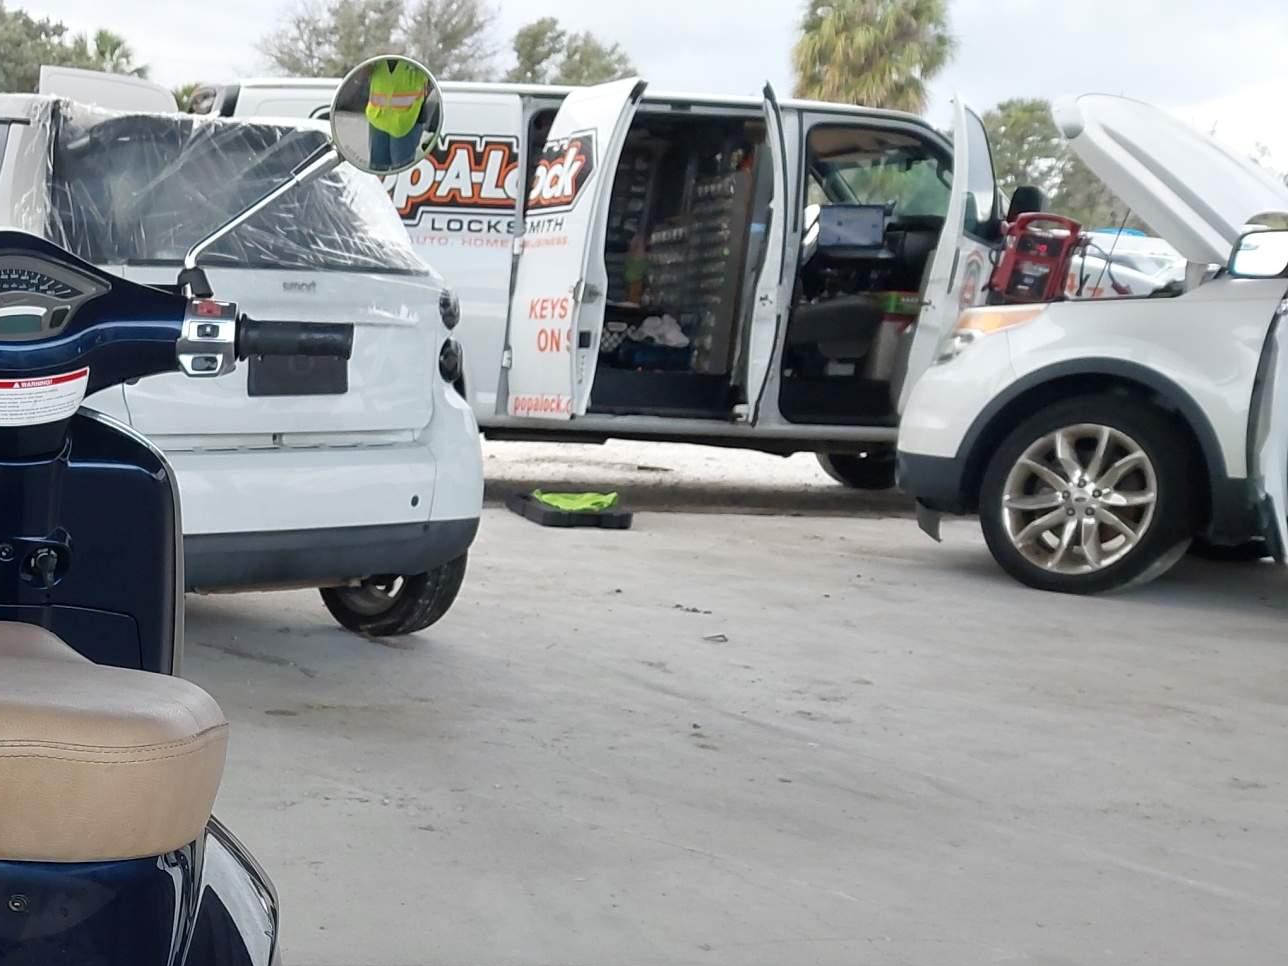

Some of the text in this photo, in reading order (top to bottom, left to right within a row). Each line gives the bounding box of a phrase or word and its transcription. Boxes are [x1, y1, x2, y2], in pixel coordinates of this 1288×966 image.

[462, 236, 511, 248] HOME
[529, 297, 569, 319] KEYS
[537, 328, 561, 352] ON
